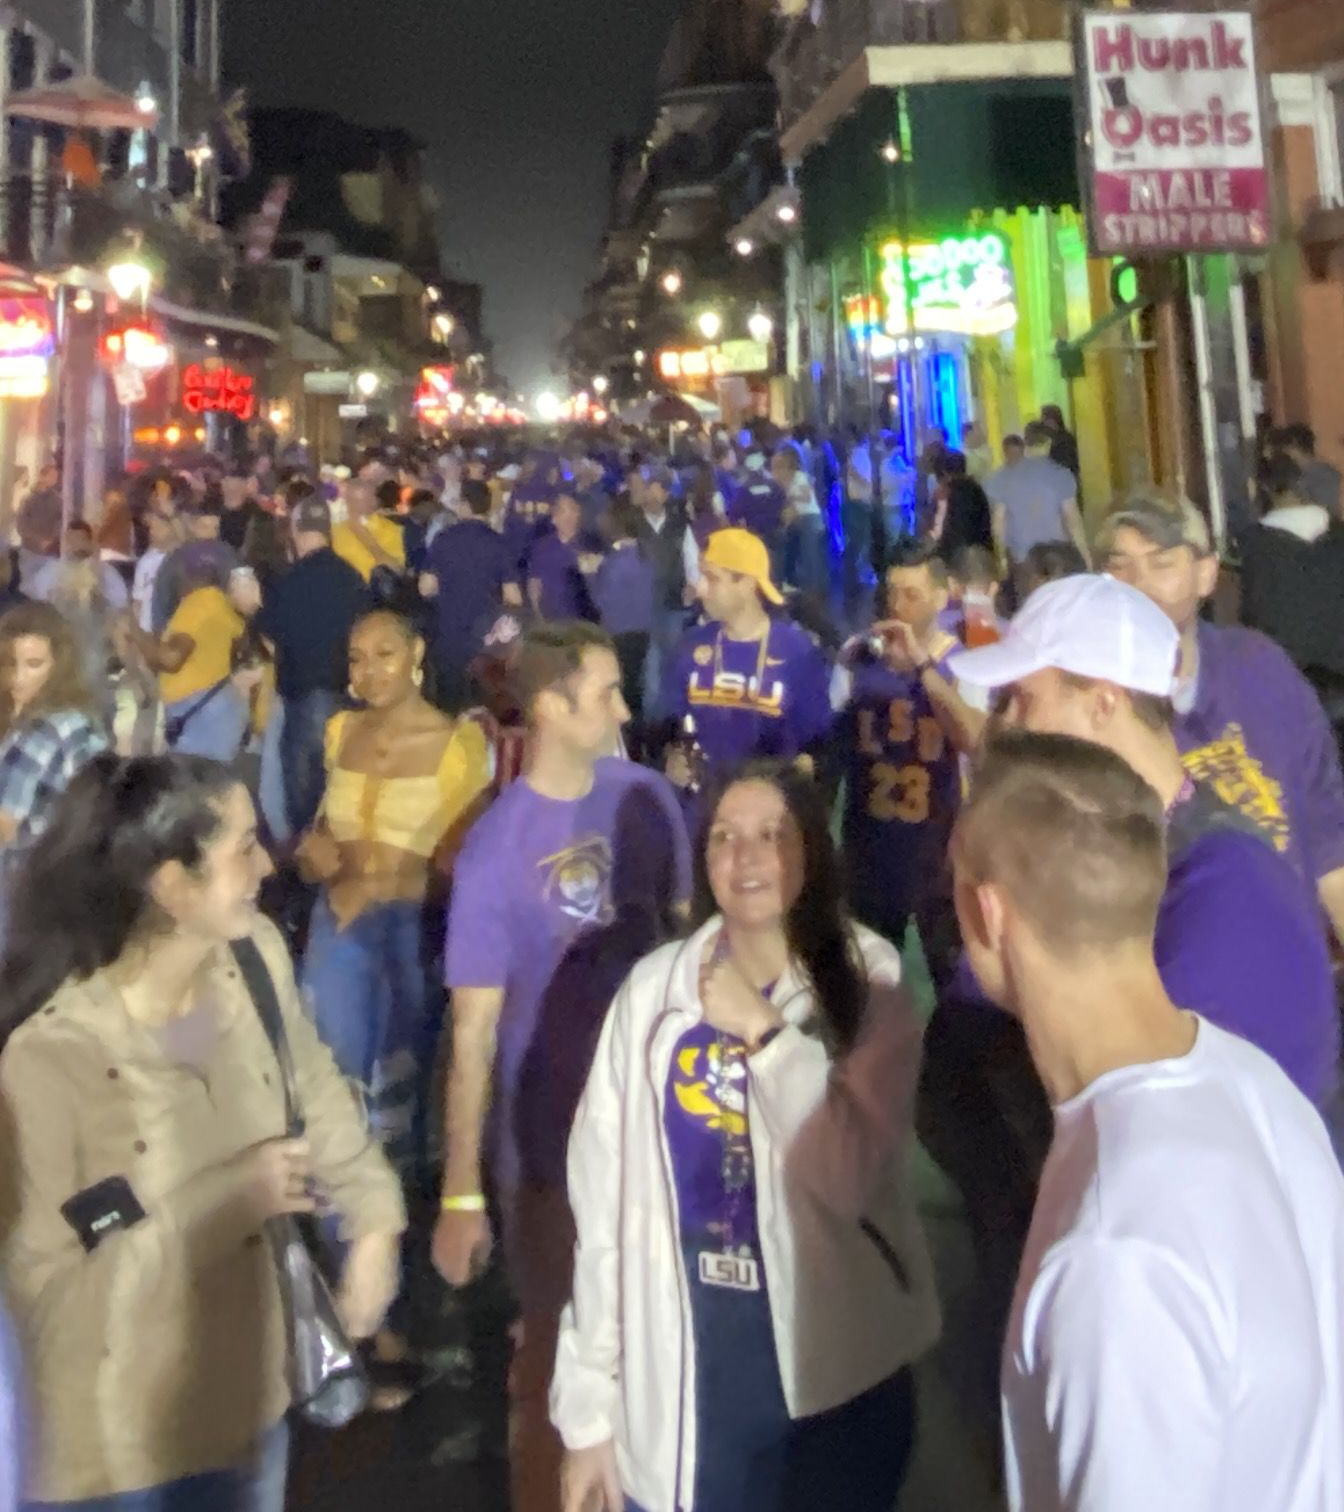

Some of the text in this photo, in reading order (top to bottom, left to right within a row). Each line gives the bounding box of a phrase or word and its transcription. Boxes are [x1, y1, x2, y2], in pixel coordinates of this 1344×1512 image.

[1093, 20, 1248, 72] Hunk
[1101, 94, 1253, 149] Oasis
[1130, 170, 1233, 209] MALE
[689, 672, 784, 708] LSU
[702, 1257, 752, 1285] LSU
